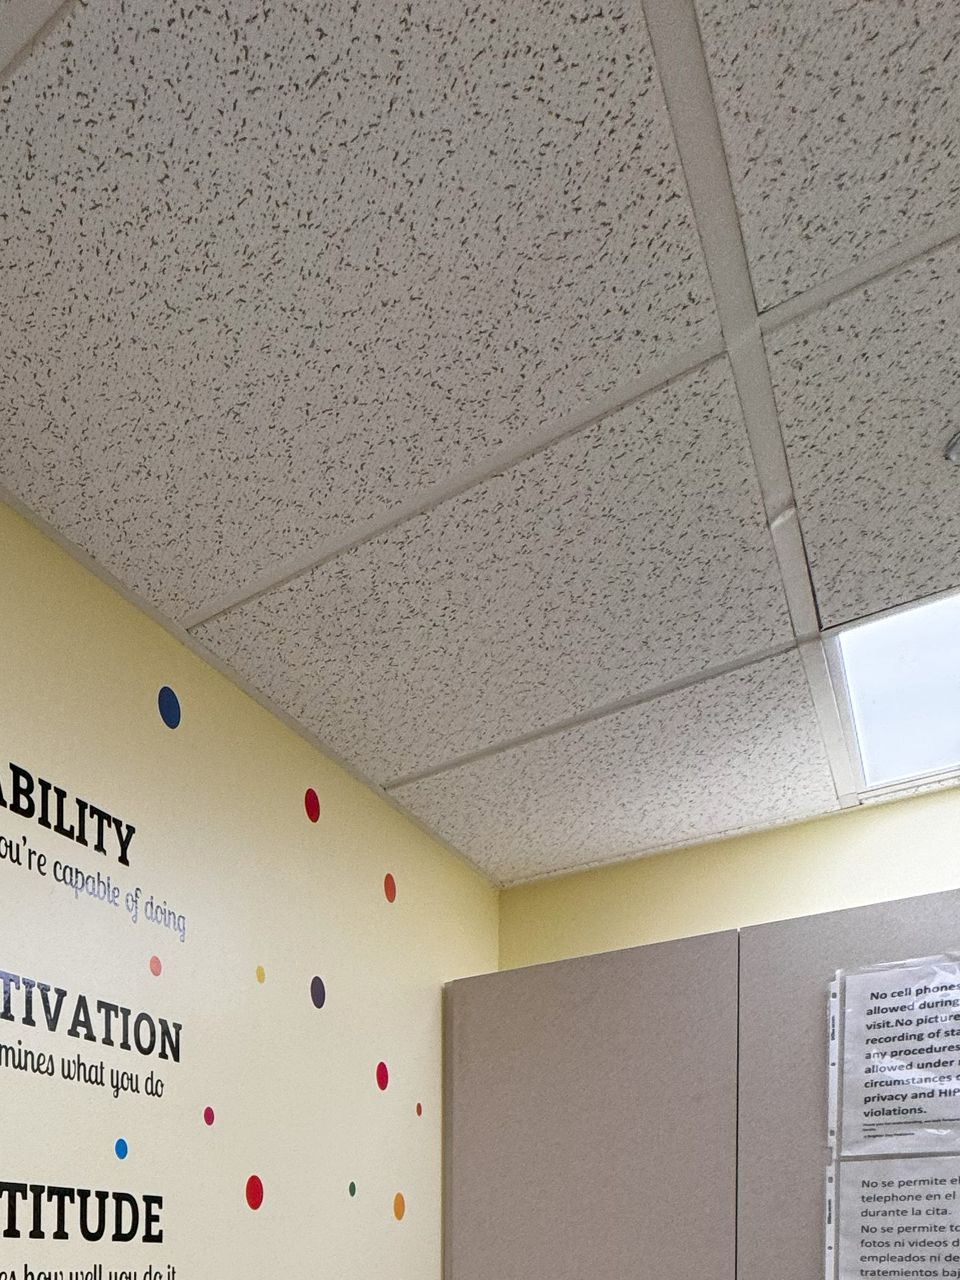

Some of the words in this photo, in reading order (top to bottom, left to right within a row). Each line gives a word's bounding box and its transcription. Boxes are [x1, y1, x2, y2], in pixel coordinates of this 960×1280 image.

[53, 860, 120, 908] capable
[125, 887, 141, 924] of
[144, 896, 186, 943] doing
[870, 991, 888, 1001] No
[890, 987, 912, 998] cell
[866, 1003, 915, 1016] allowed
[918, 998, 960, 1010] during
[865, 1032, 924, 1046] recording
[927, 1028, 941, 1039] of
[865, 1050, 887, 1061] any
[890, 1044, 960, 1058] procedures
[864, 1062, 914, 1074] allowed
[917, 1059, 955, 1070] under
[61, 1054, 106, 1087] what
[110, 1069, 140, 1099] you
[144, 1070, 164, 1098] do
[864, 1074, 952, 1089] circumstances
[863, 1093, 908, 1105] privacy
[911, 1089, 935, 1100] and
[863, 1106, 927, 1118] violations.
[861, 1179, 878, 1188] No
[881, 1180, 895, 1188] se
[898, 1177, 947, 1190] permite
[861, 1193, 922, 1204] telephone
[925, 1192, 941, 1201] en
[945, 1191, 956, 1200] el
[860, 1208, 909, 1218] durante
[911, 1207, 922, 1216] la
[925, 1206, 952, 1216] cita.
[861, 1225, 878, 1233] No
[897, 1224, 946, 1235] permite
[860, 1239, 891, 1248] fotos
[893, 1239, 905, 1248] ni
[908, 1238, 949, 1248] videos
[859, 1253, 926, 1264] empleados
[929, 1253, 941, 1262] ni
[859, 1267, 939, 1278] tratemientos
